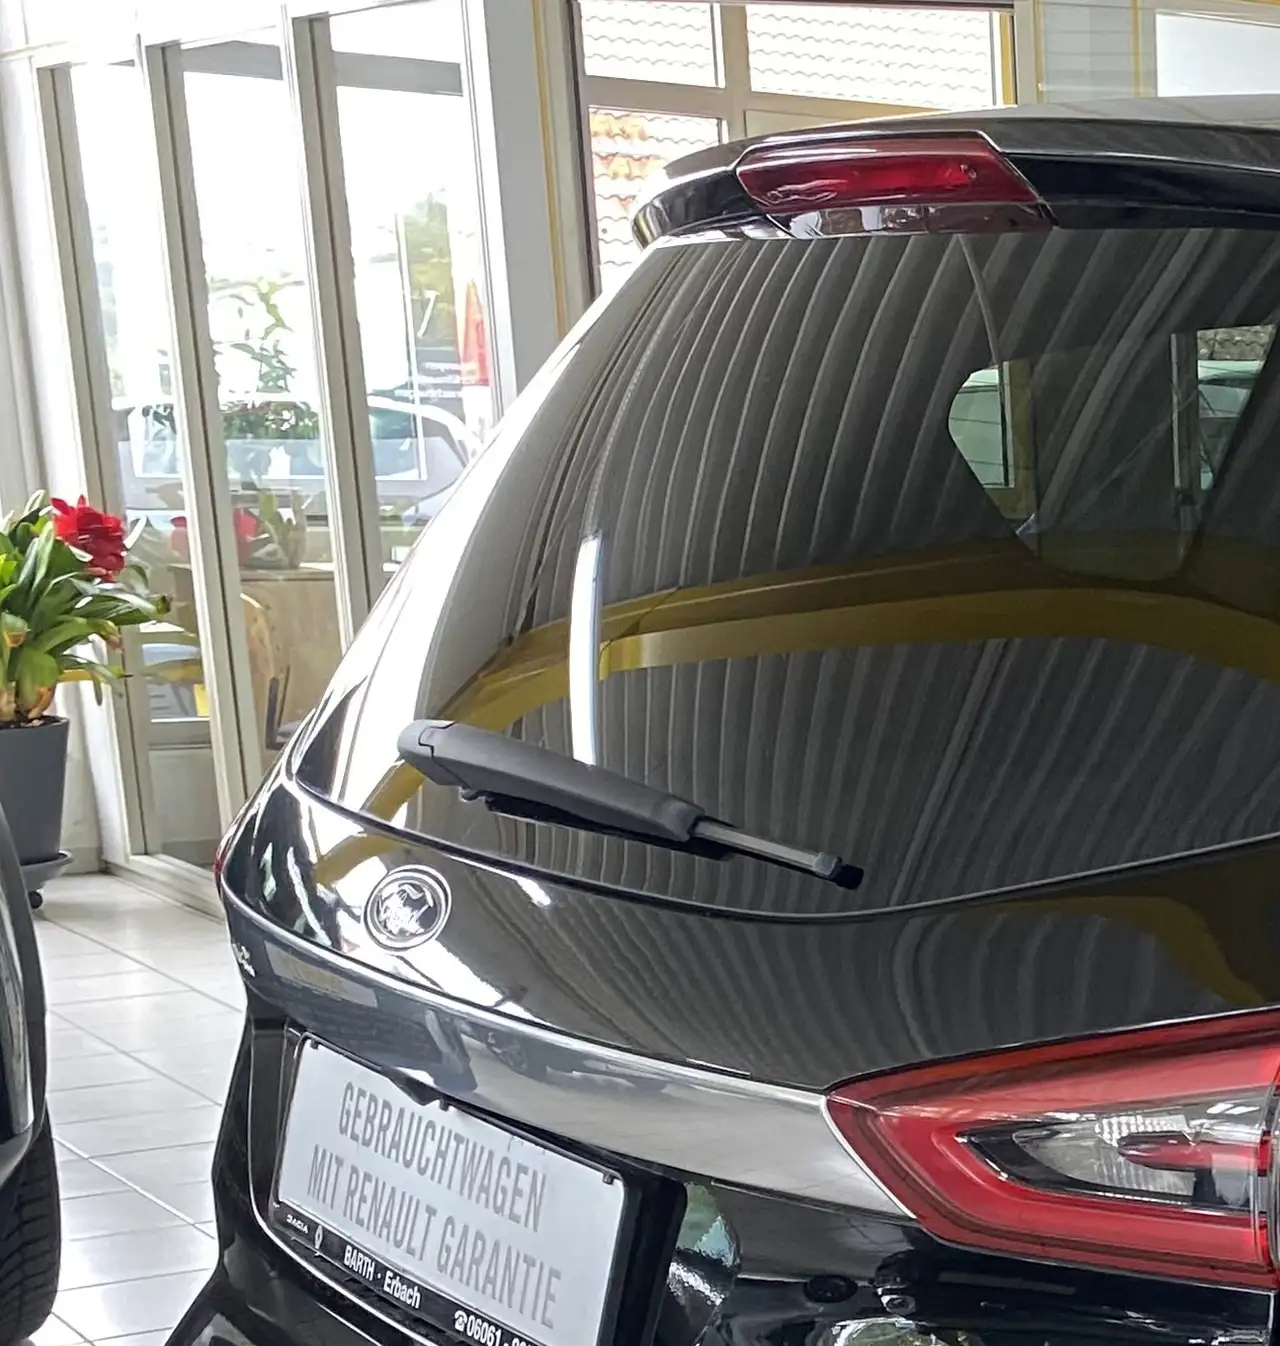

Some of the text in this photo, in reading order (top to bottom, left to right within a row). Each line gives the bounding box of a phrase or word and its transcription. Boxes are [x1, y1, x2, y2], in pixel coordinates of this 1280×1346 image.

[339, 1081, 547, 1233] GEBRAUCHTWAGEN
[307, 1143, 562, 1330] MIT RENAULT GARANTIE
[343, 1244, 375, 1282] BARTH
[383, 1270, 421, 1309] Erbach
